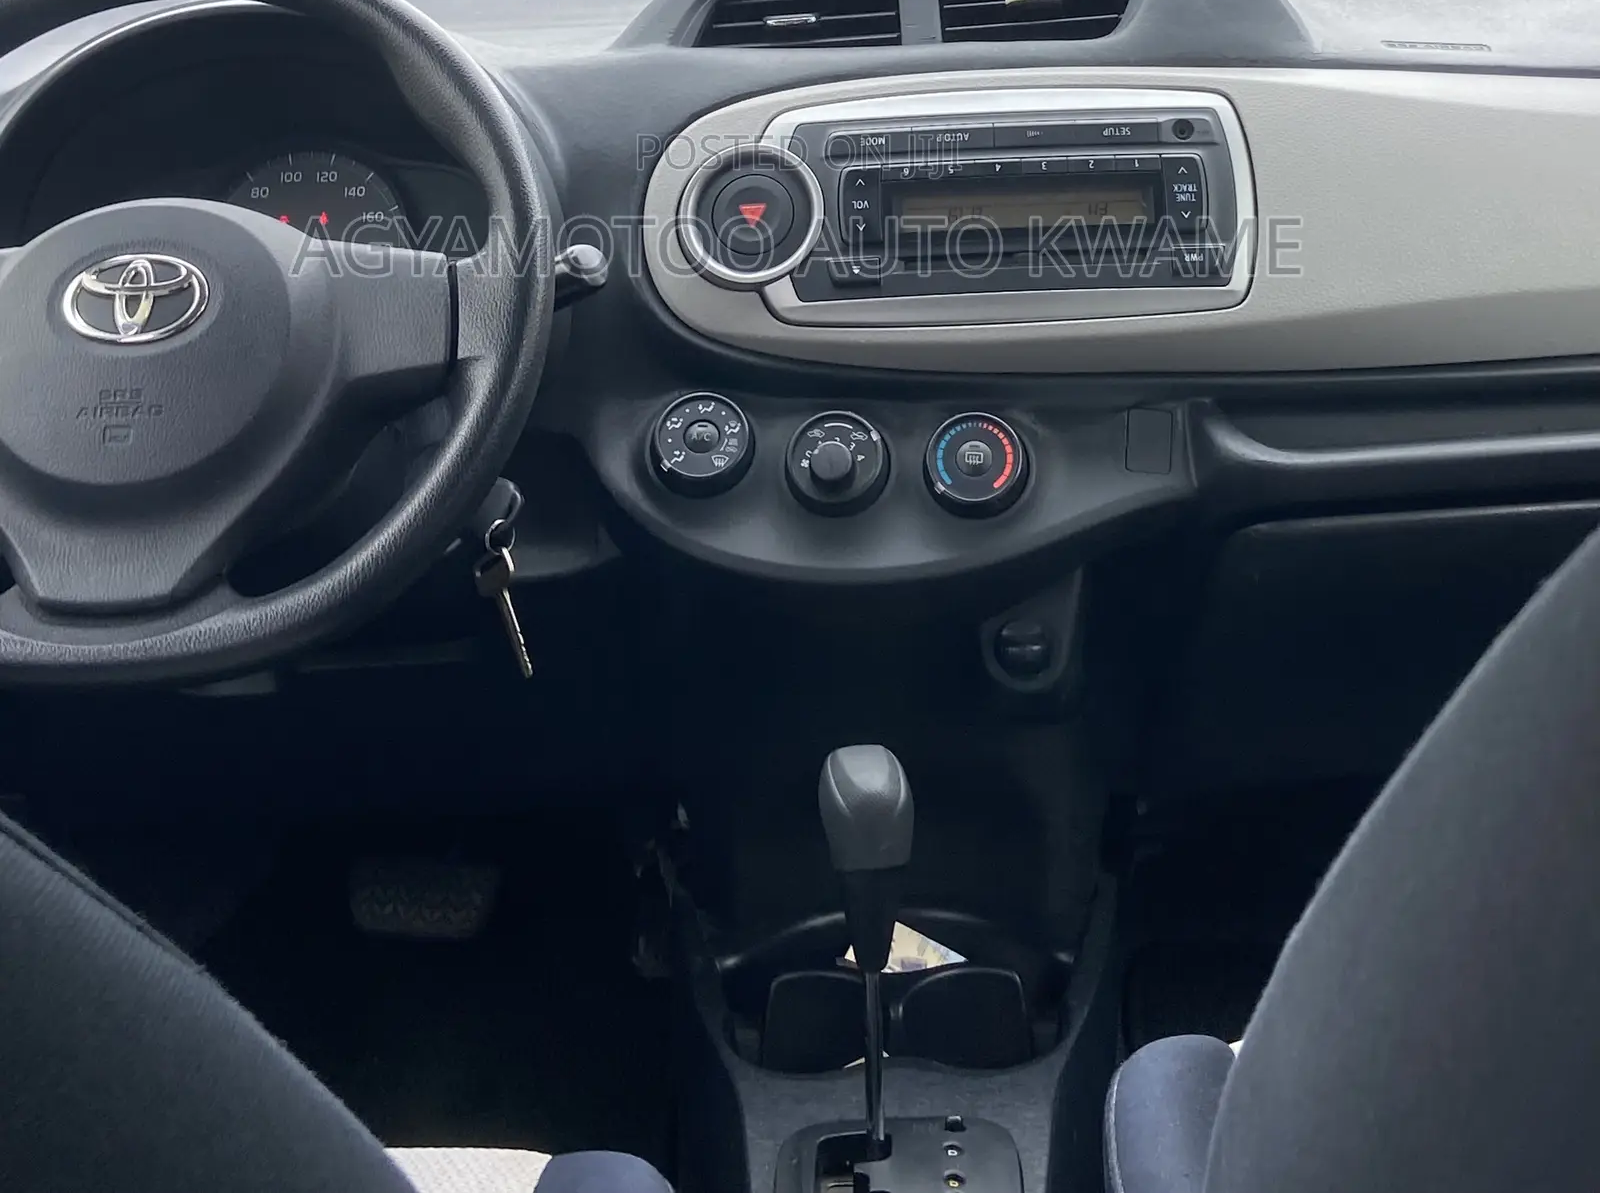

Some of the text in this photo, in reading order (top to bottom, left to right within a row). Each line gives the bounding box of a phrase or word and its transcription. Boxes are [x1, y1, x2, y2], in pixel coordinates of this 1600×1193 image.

[1102, 126, 1132, 137] SETUP
[860, 136, 886, 146] MODE
[902, 160, 1139, 176] 6 5 4 3 2 1
[280, 170, 303, 184] 100
[316, 170, 339, 183] 120
[250, 185, 270, 199] 80
[344, 186, 366, 199] 140
[1172, 183, 1198, 192] TRACK
[1175, 192, 1197, 202] TUNE
[851, 200, 870, 209] VOL
[362, 210, 385, 223] 160
[1183, 252, 1204, 262] PWR
[690, 430, 713, 443] A/C
